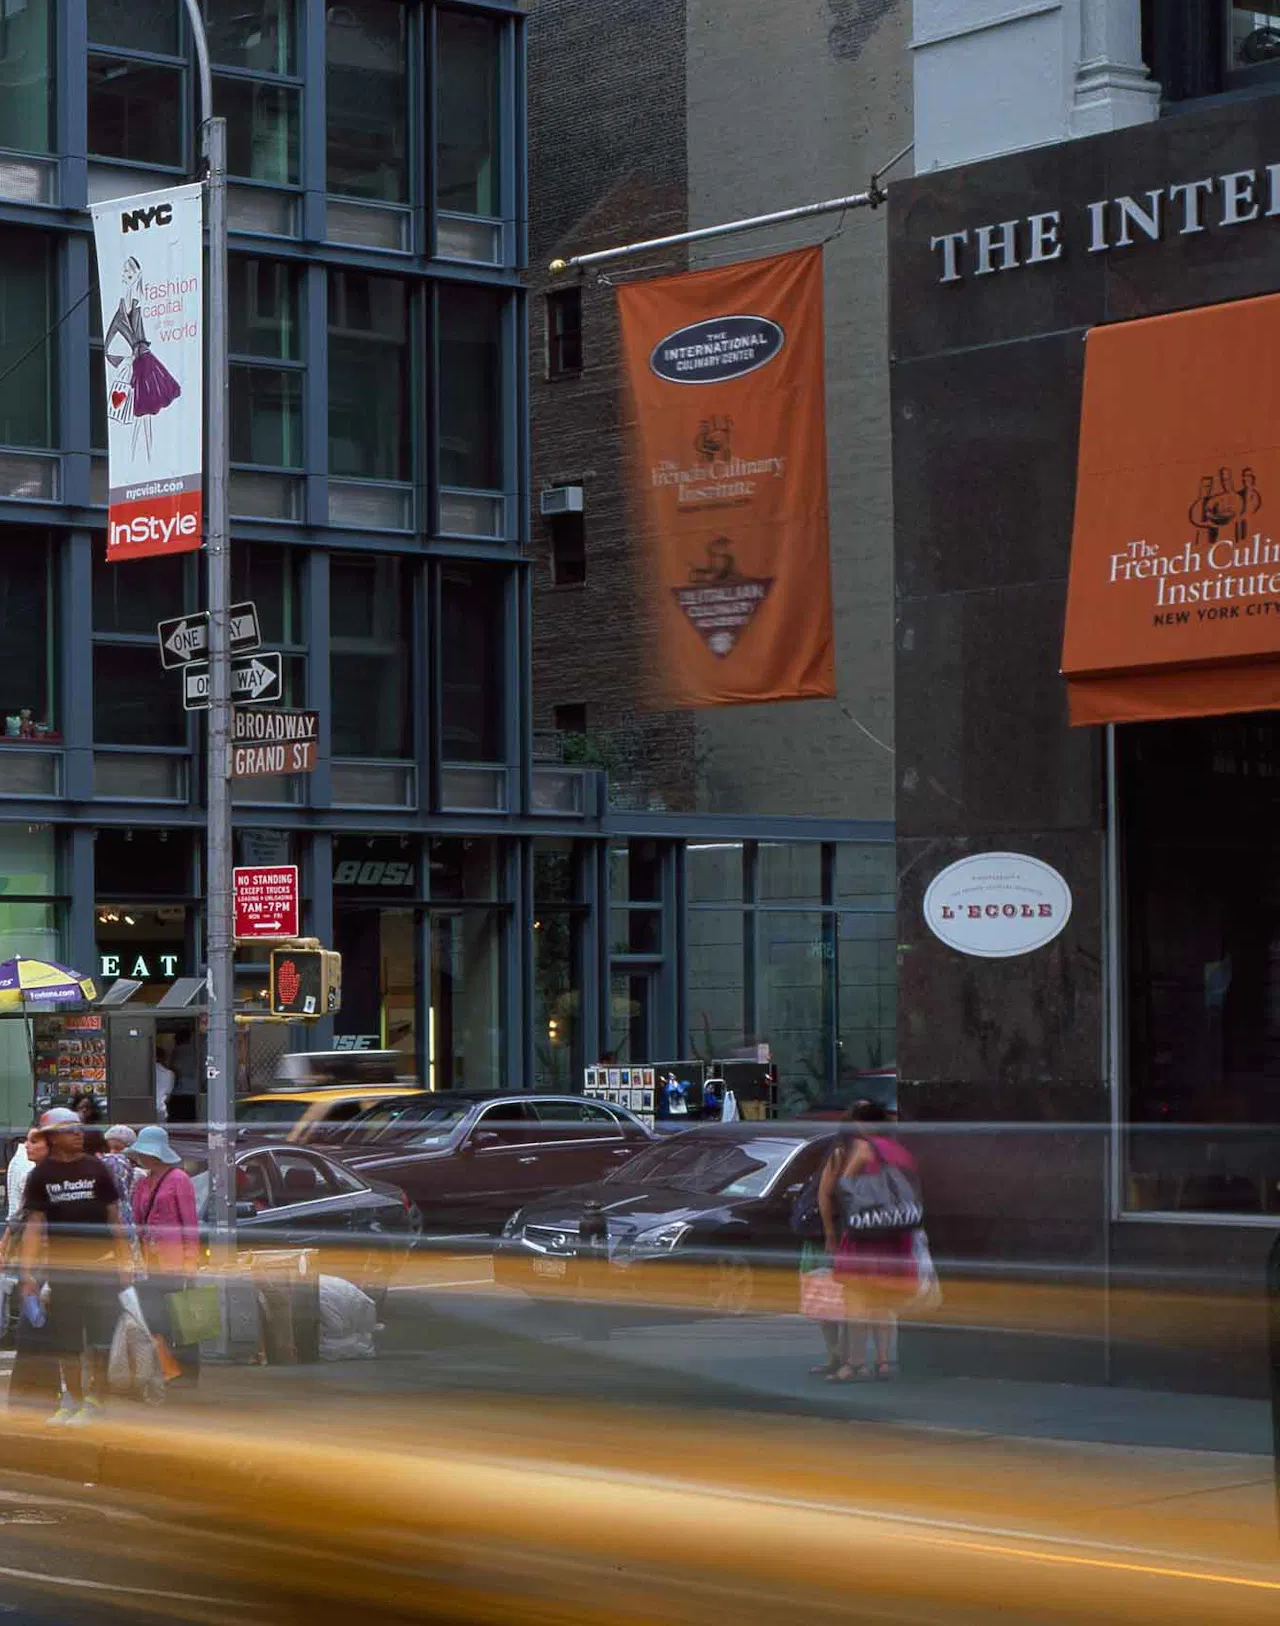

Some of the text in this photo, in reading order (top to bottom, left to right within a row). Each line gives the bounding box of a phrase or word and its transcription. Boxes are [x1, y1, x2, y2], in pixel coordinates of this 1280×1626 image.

[121, 203, 172, 233] NYC
[930, 211, 1062, 282] THE
[144, 277, 198, 300] fashion
[143, 298, 183, 319] capital
[160, 323, 197, 342] world
[707, 332, 727, 341] THE
[664, 333, 768, 361] INTERNATIONAL
[676, 348, 755, 371] CULINARY CENTER
[126, 480, 184, 500] nycvisit.com
[110, 511, 197, 545] InStyle
[1127, 540, 1159, 558] The
[1110, 542, 1201, 582] French
[1156, 573, 1280, 606] Institute
[1153, 601, 1280, 627] NEW YORK CITY
[174, 630, 200, 652] ONE
[238, 668, 266, 690] WAY
[237, 713, 315, 739] BROADWAY
[236, 742, 310, 774] GRAND ST
[238, 874, 293, 886] NO STANDING
[241, 886, 290, 895] EXCEPT TRUCKS
[241, 902, 290, 912] 7AM-7PM
